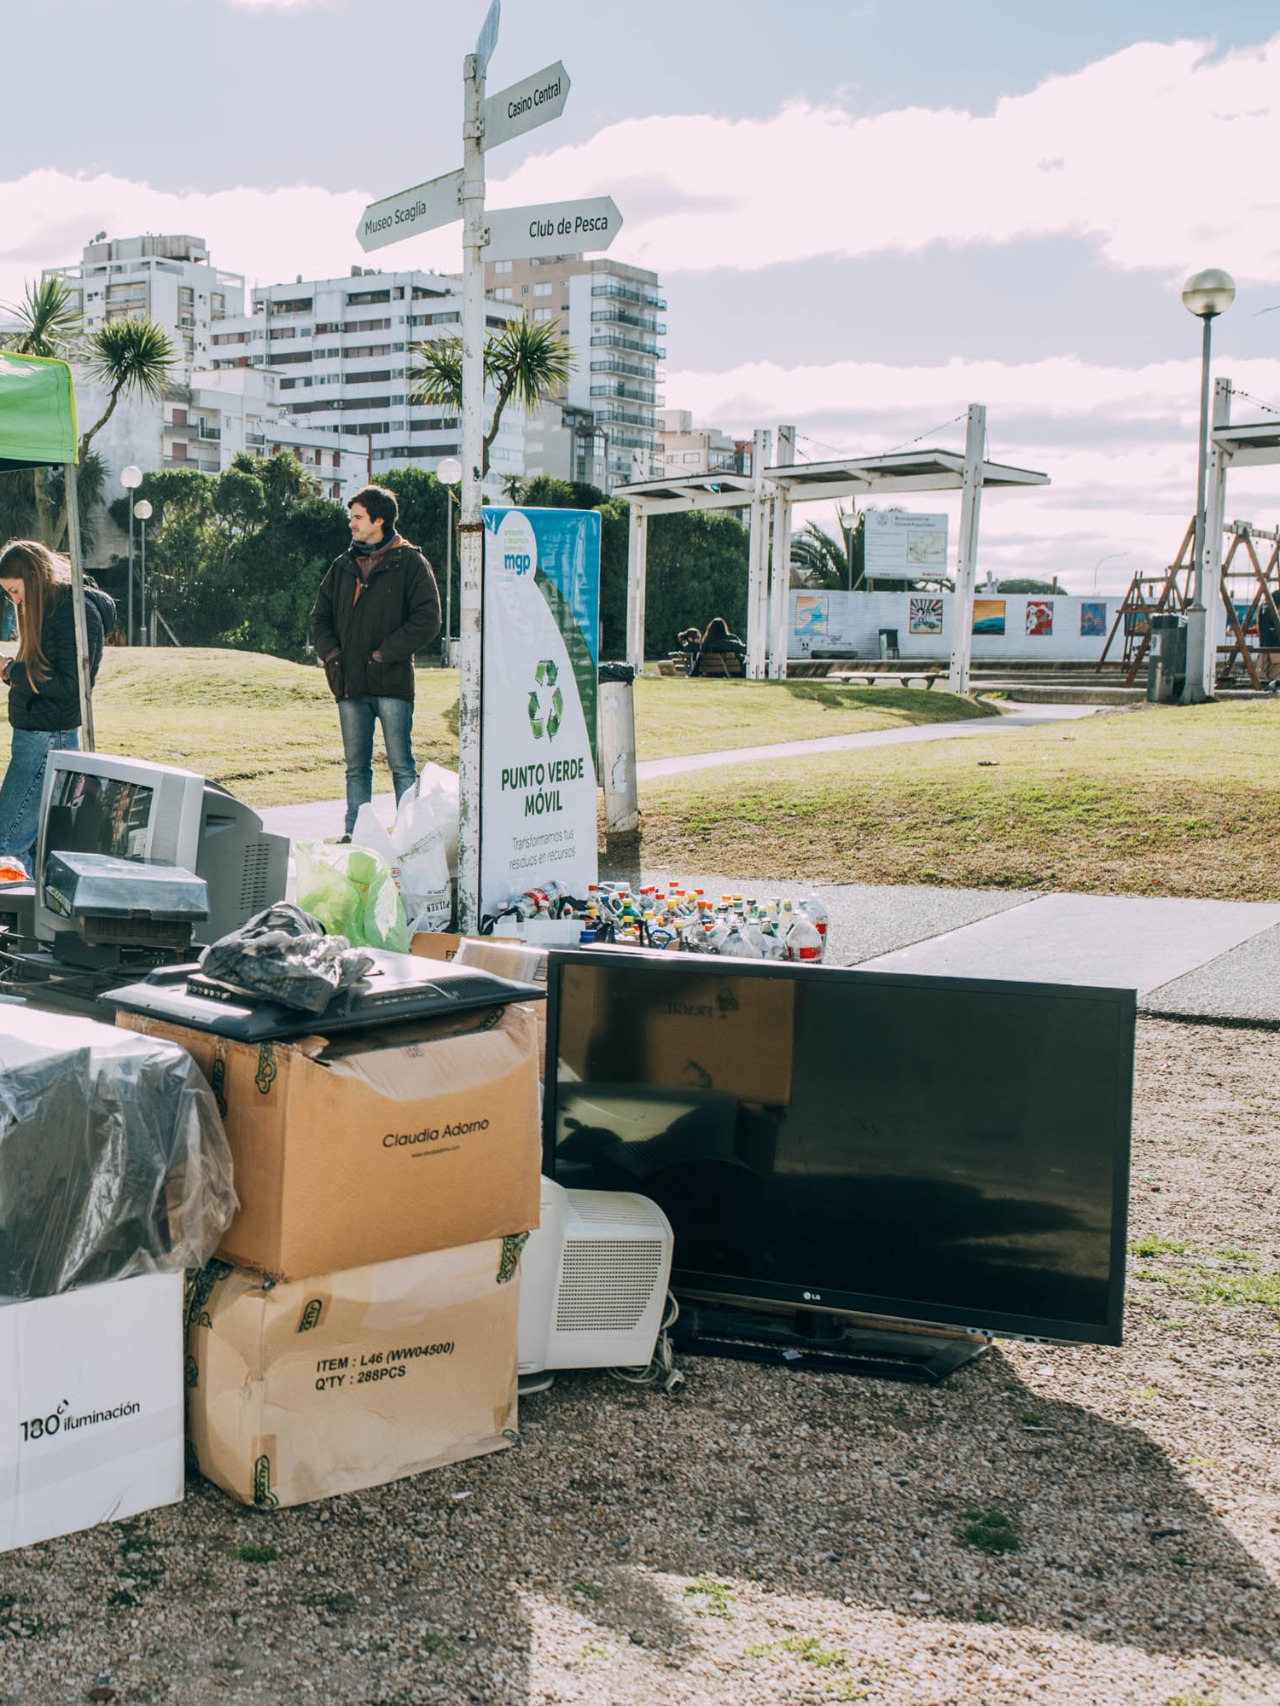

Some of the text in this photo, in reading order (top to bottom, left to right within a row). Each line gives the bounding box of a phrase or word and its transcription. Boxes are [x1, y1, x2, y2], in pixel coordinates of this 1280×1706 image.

[507, 77, 561, 119] Casino Central
[365, 201, 427, 236] Museo Scaglia
[529, 215, 609, 238] Club de Pesca
[504, 554, 531, 576] mgp
[501, 757, 585, 791] PUNTO VERDE
[524, 788, 563, 817] MÓVIL
[512, 828, 576, 851] Transformamos tus
[547, 846, 576, 863] recursos
[382, 1118, 490, 1148] Claudia Adorno
[316, 1357, 349, 1373] ITEM
[360, 1352, 384, 1367] L46
[386, 1342, 456, 1365] (WW04500)
[315, 1375, 346, 1391] Q'TY
[357, 1365, 407, 1384] 288PCS
[64, 1401, 141, 1432] iluminación
